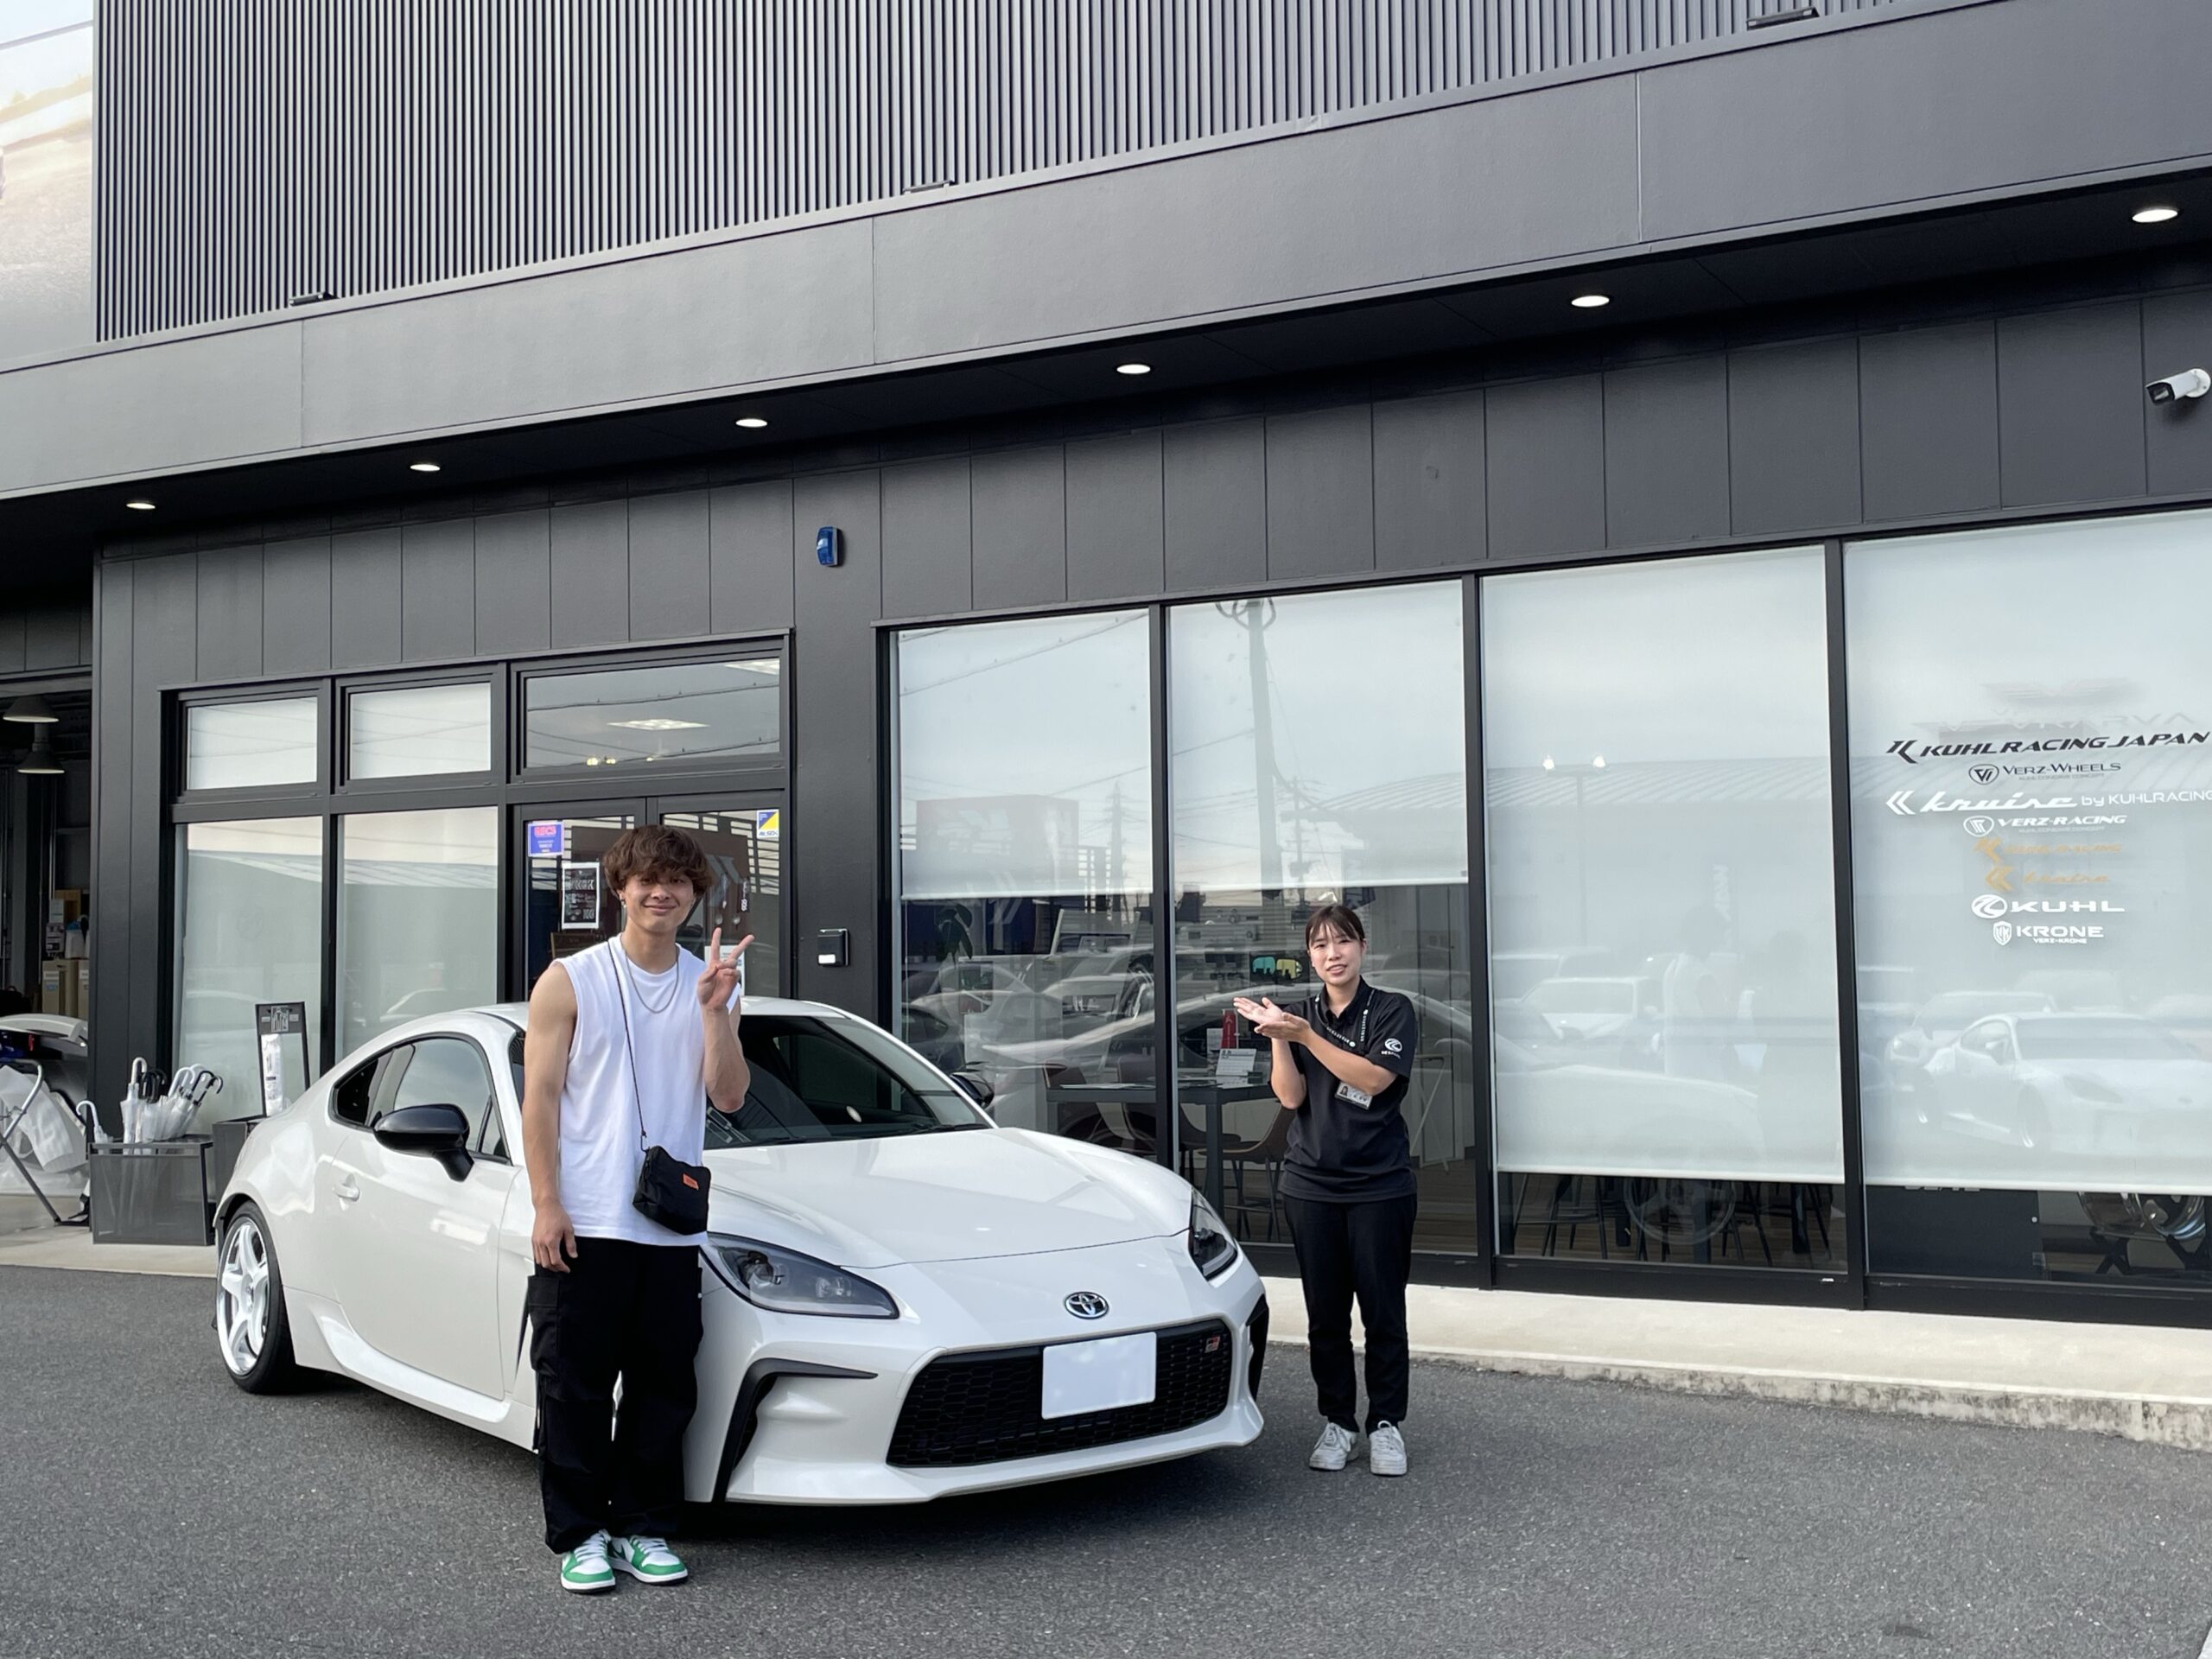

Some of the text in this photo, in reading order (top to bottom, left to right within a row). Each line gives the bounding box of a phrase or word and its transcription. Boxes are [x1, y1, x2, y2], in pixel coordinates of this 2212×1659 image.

[1920, 731, 2211, 757] KUHL RACING JAPAN
[2082, 795, 2105, 807] by
[1997, 815, 2128, 827] VERZ-RACING
[2011, 900, 2126, 913] KUHL
[2016, 925, 2104, 938] KRONE
